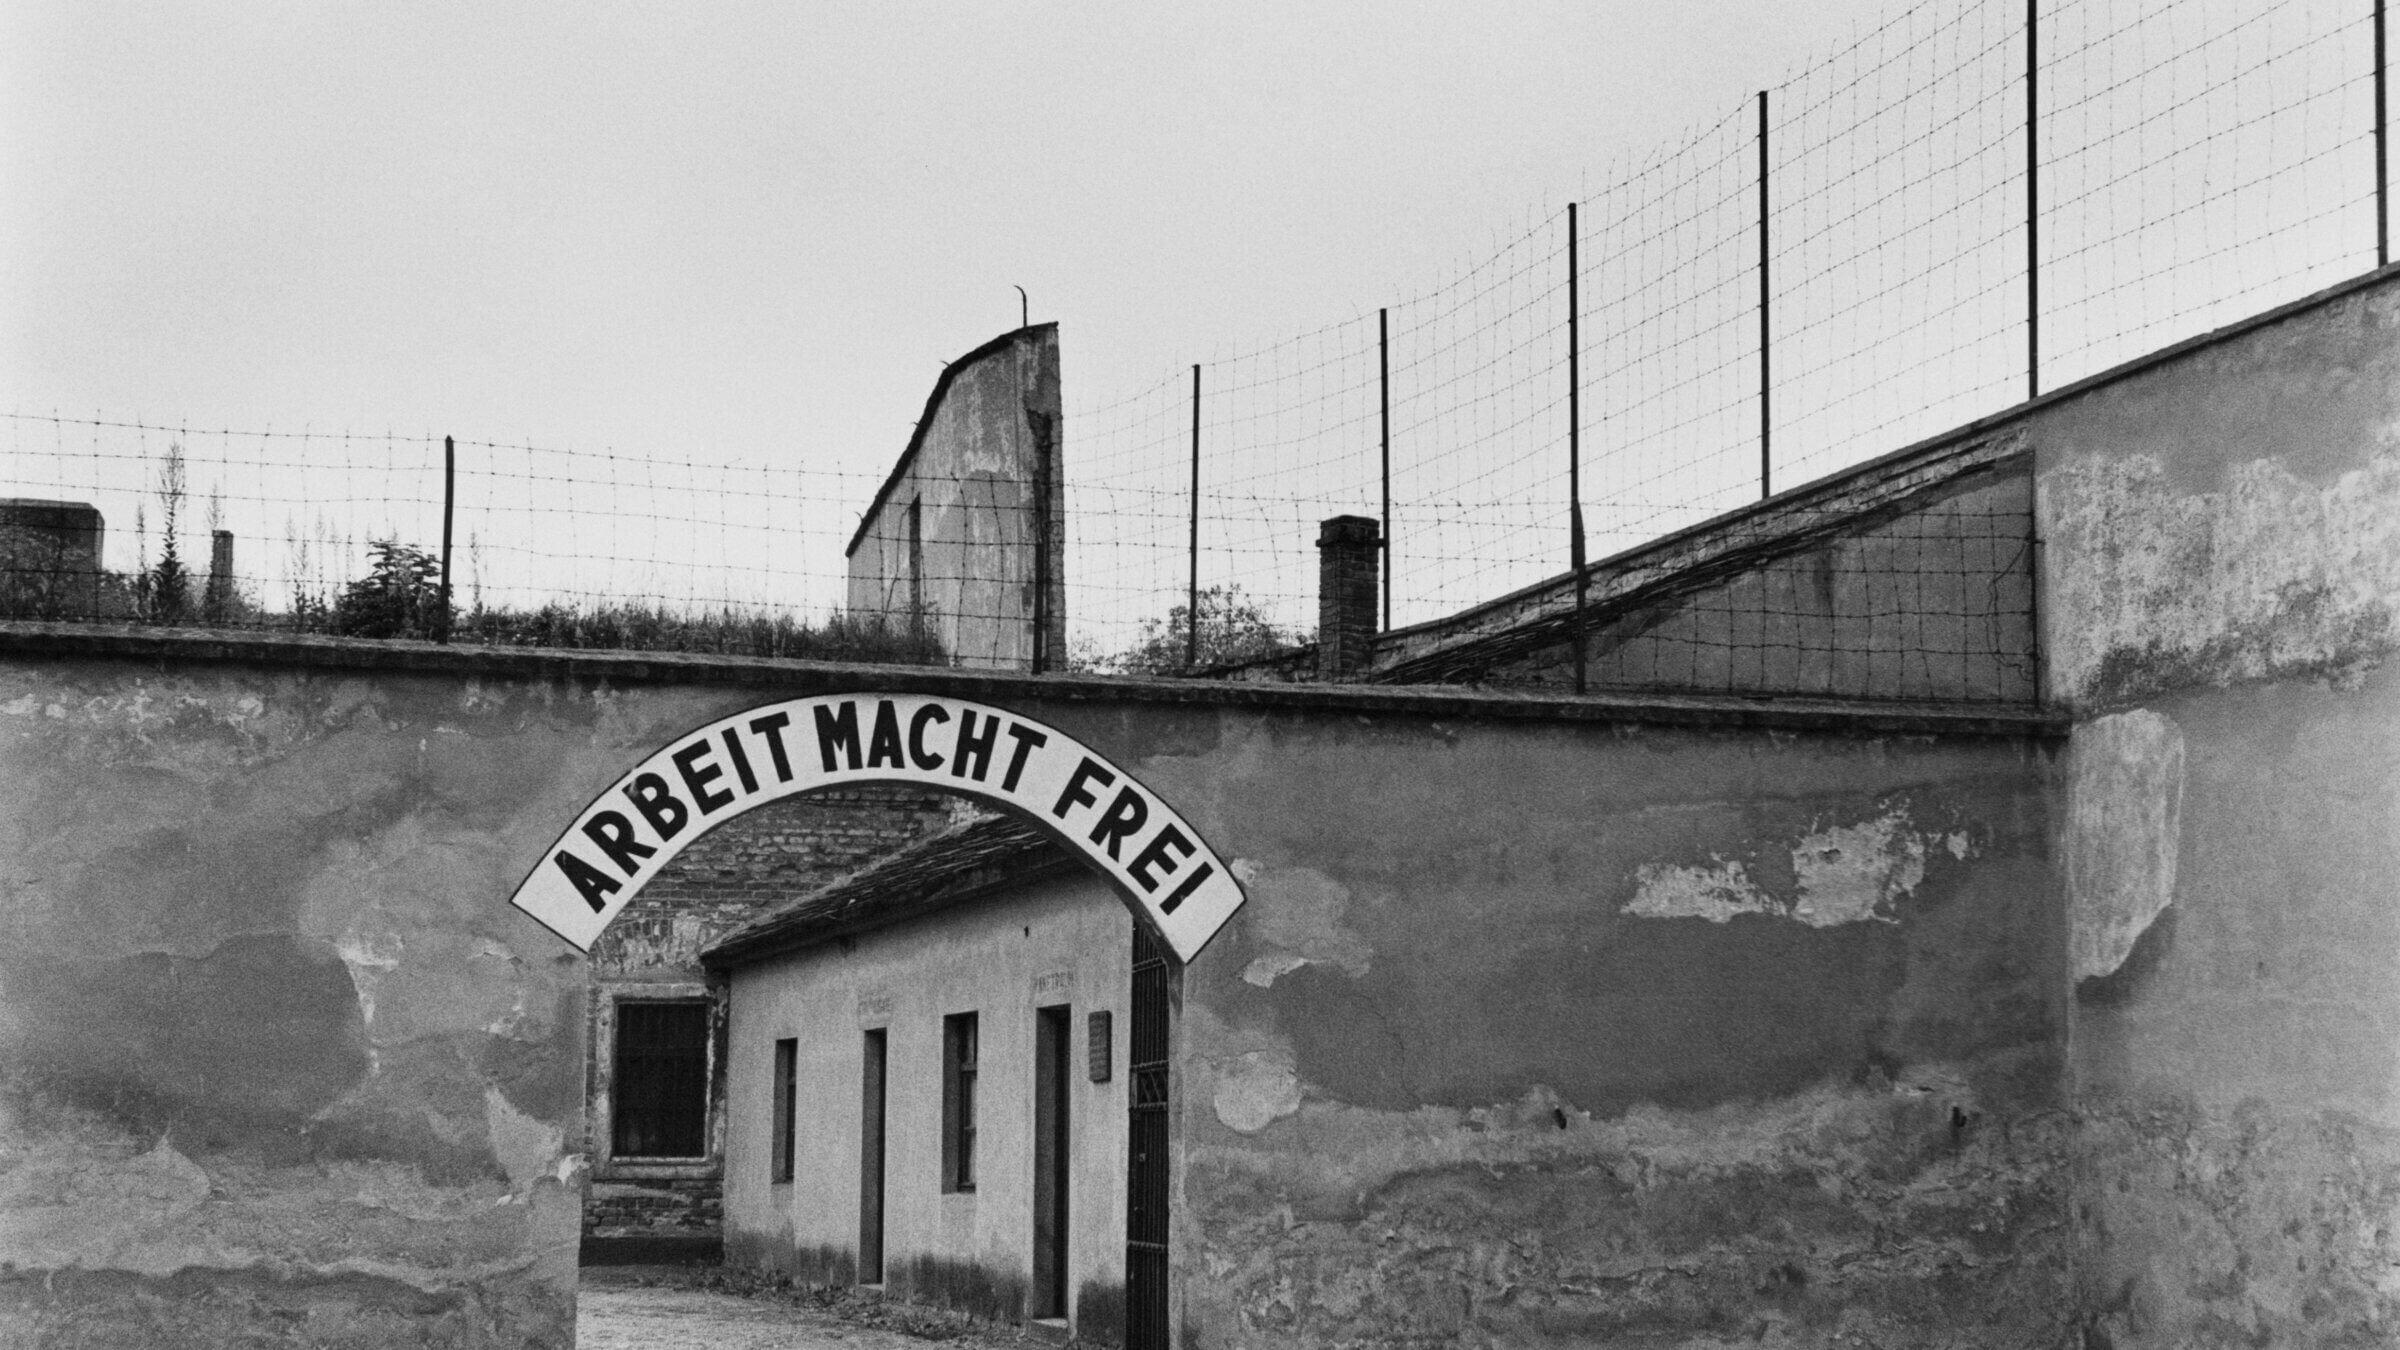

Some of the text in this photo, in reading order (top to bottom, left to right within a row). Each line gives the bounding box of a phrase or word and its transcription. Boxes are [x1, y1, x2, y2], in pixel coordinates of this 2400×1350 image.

[553, 699, 1214, 916] ARBEIT MACHT FREI
